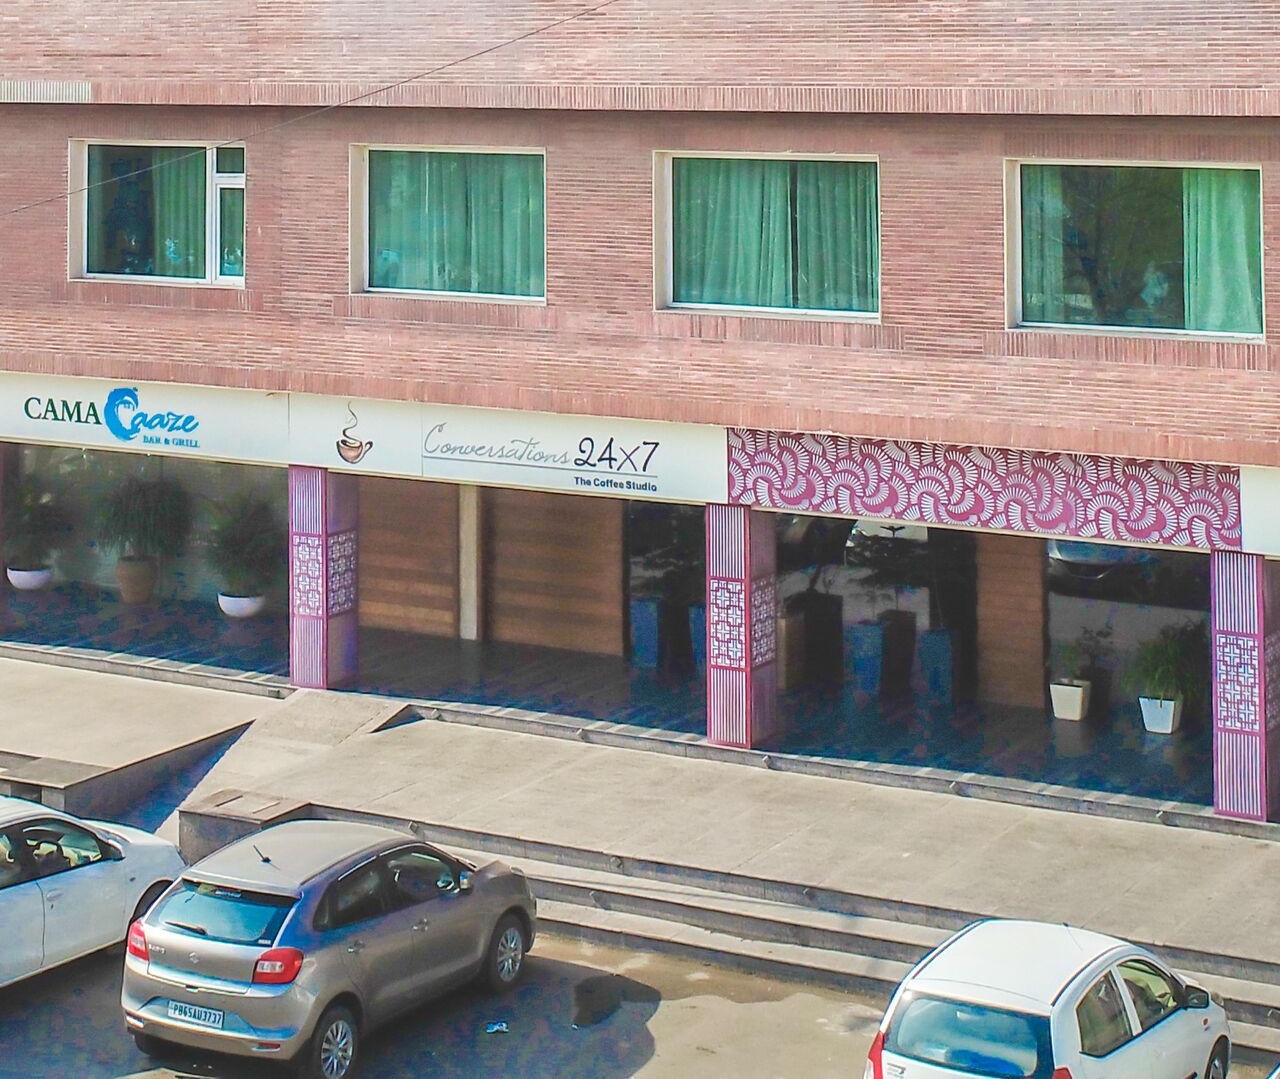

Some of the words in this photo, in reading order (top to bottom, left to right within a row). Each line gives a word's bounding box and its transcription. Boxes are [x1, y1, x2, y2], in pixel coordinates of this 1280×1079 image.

[24, 397, 103, 426] CAMA
[103, 386, 200, 442] Caaze
[142, 435, 161, 445] BAR
[164, 437, 170, 446] &
[172, 436, 200, 448] GRILL
[423, 421, 571, 465] Conversations
[573, 475, 592, 488] The
[593, 477, 625, 490] Coffee
[626, 480, 658, 492] Studio
[172, 1005, 222, 1025] PB65AU3737
